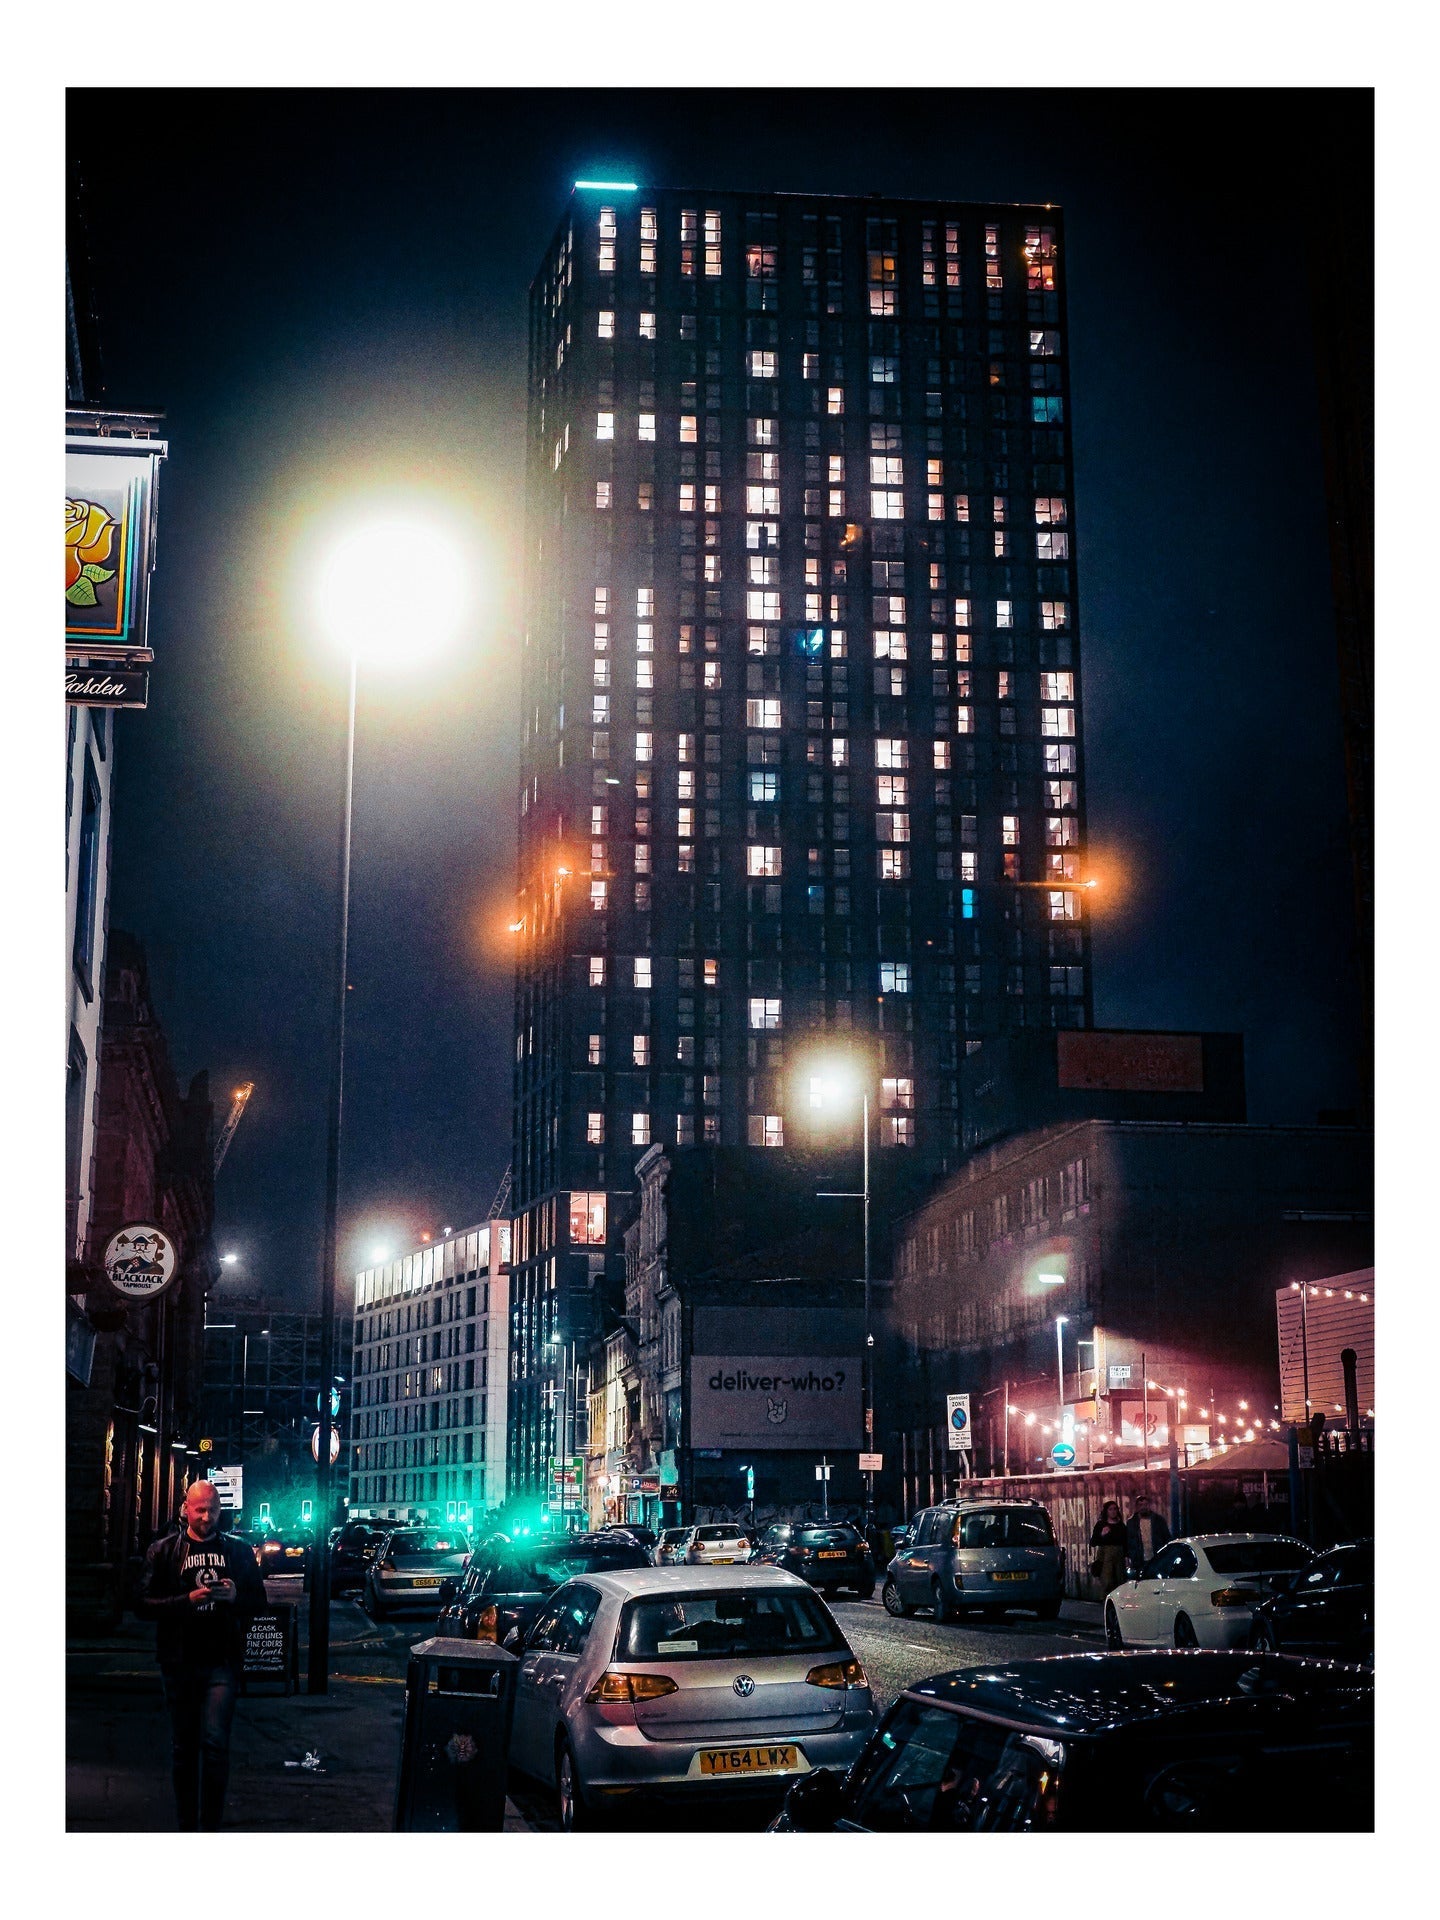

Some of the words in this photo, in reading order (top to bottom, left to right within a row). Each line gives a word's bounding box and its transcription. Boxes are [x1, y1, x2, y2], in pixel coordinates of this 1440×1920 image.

[112, 1274, 163, 1284] BLACKJACK
[709, 1370, 846, 1392] deliver-who?
[208, 1553, 226, 1567] TRA
[265, 1632, 283, 1640] LINES
[247, 1640, 260, 1648] FINE
[706, 1752, 752, 1770] YT64
[756, 1748, 790, 1766] LWX
